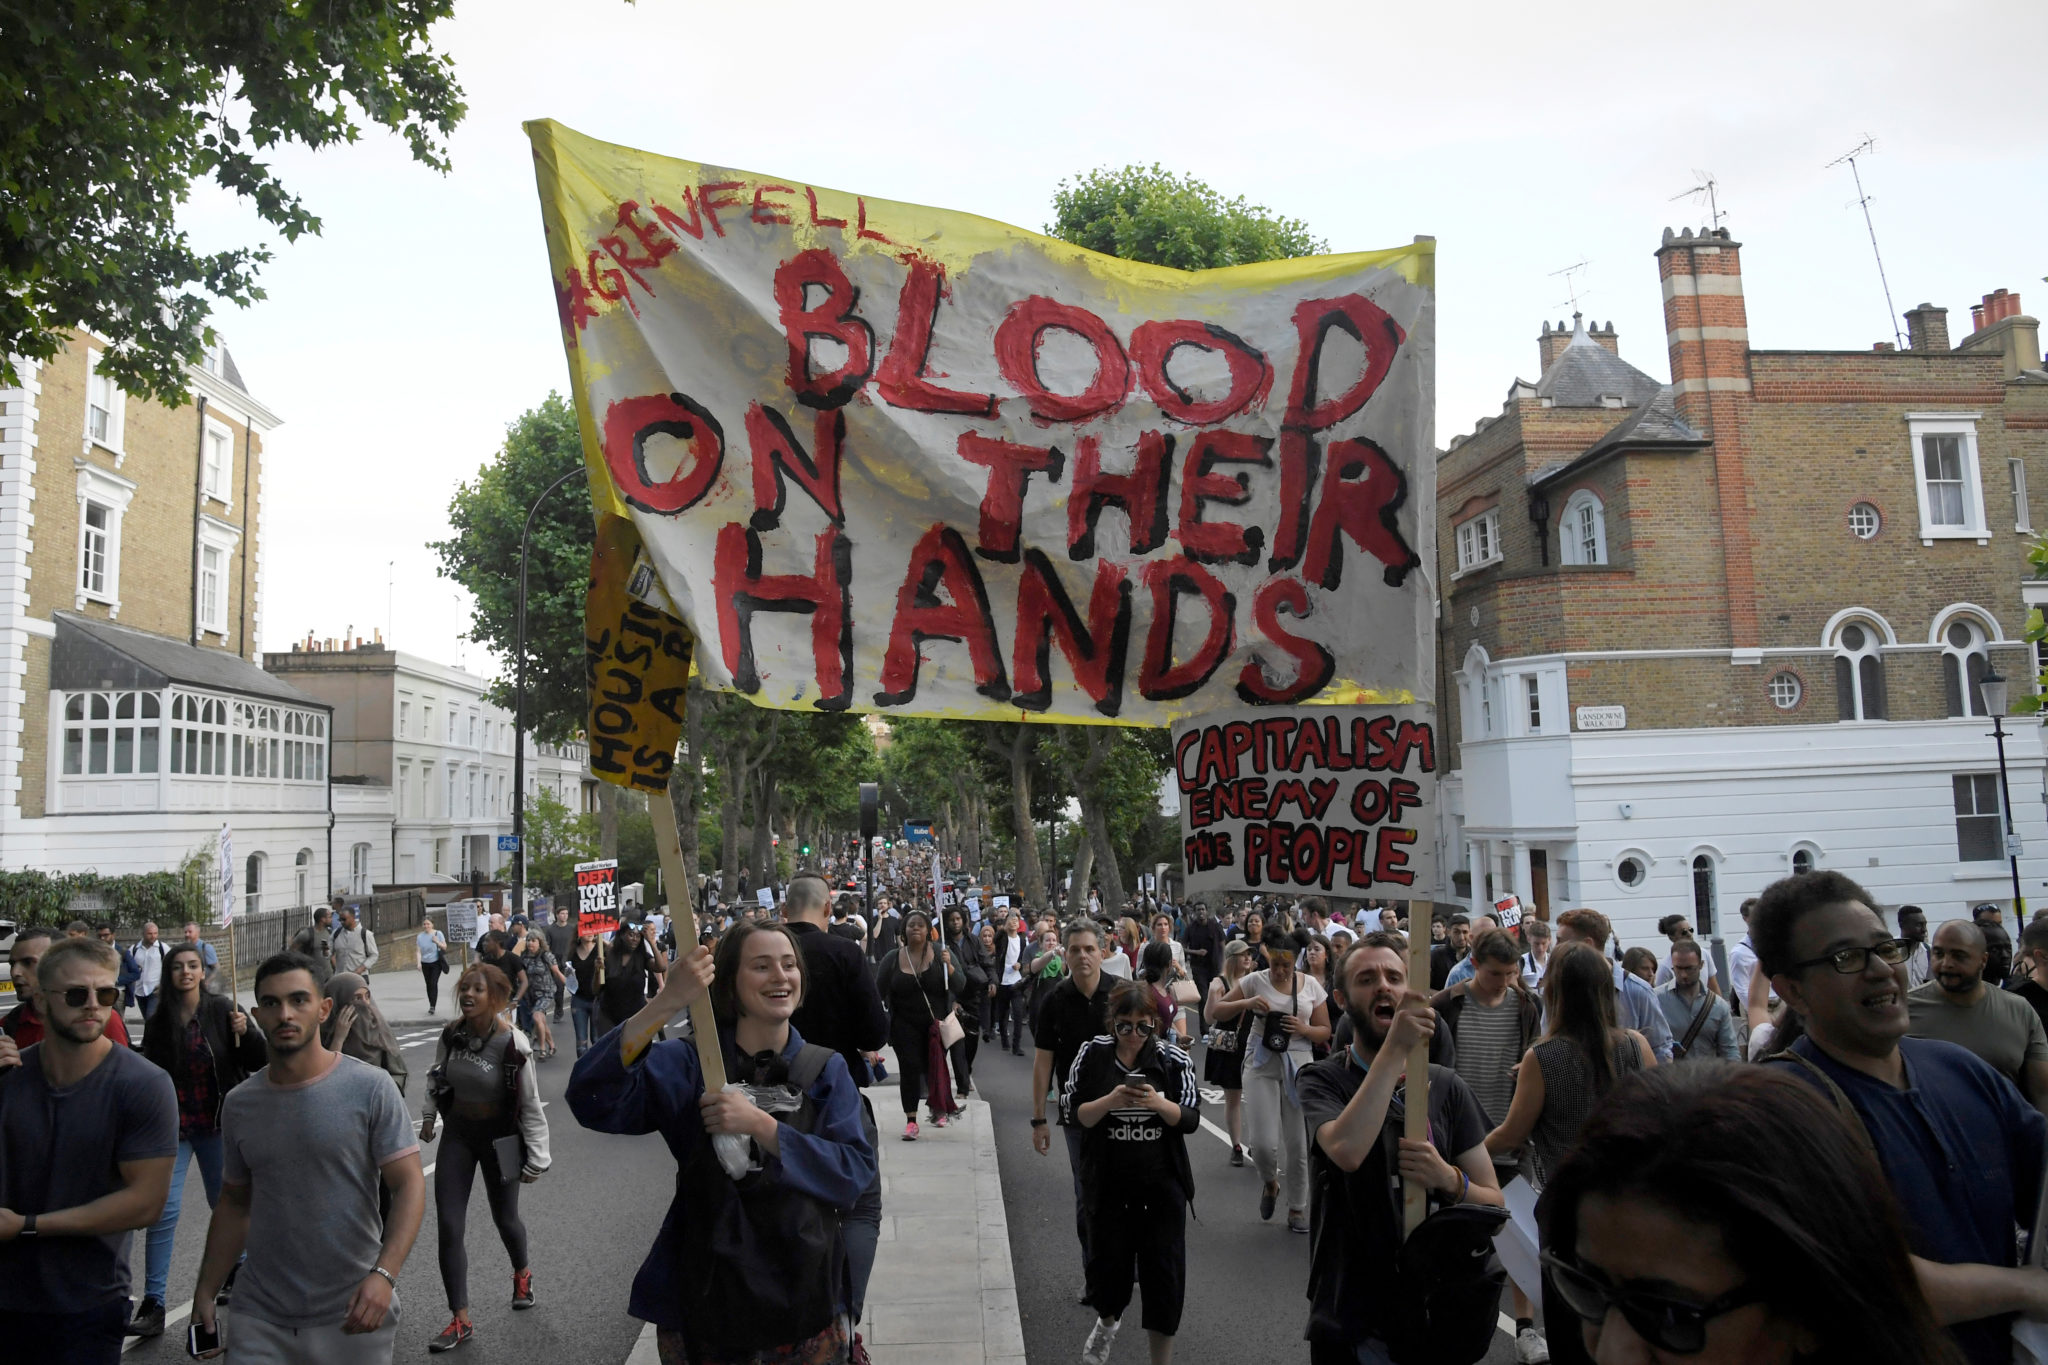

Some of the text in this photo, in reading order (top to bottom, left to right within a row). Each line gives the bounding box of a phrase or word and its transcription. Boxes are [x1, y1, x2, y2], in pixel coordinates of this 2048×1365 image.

[774, 247, 1408, 432] BLOOD
[602, 392, 847, 532] ON
[957, 427, 1422, 592] THEIR
[711, 520, 1336, 717] HANDS
[1578, 711, 1624, 720] LANSDOWNE
[1176, 715, 1436, 794] CAPITALISM
[1190, 777, 1422, 830] ENEMY OF
[577, 868, 615, 886] DEFY
[1185, 821, 1418, 891] THE PEOPLE
[577, 881, 615, 900] TORY
[579, 895, 616, 914] RULE
[1107, 1124, 1163, 1141] adidas
